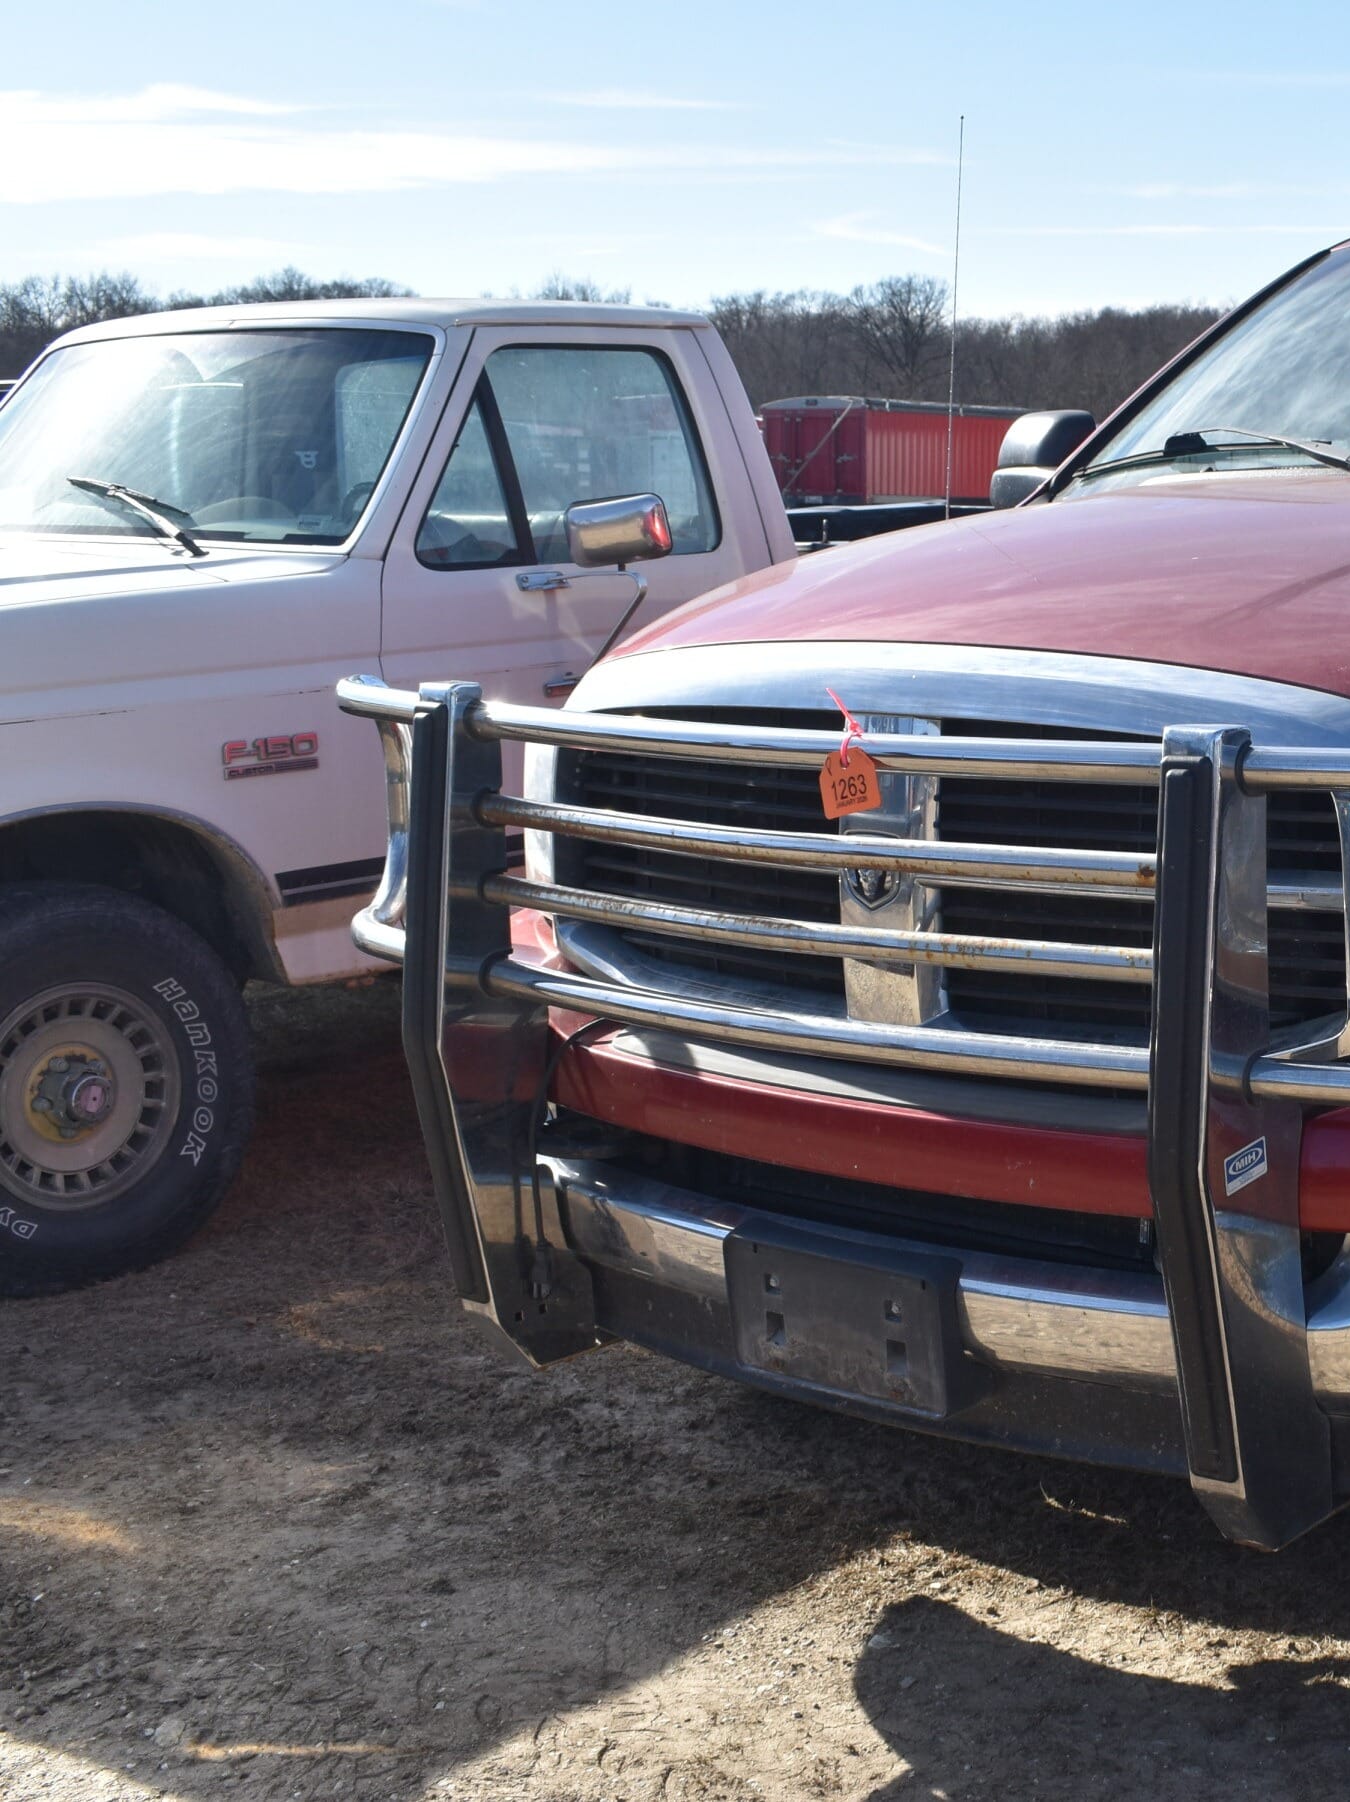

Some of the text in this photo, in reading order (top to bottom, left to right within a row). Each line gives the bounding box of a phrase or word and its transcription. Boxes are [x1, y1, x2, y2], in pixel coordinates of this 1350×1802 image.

[222, 732, 319, 765] F-150
[831, 774, 867, 801] 1263
[1235, 1151, 1257, 1171] MIH
